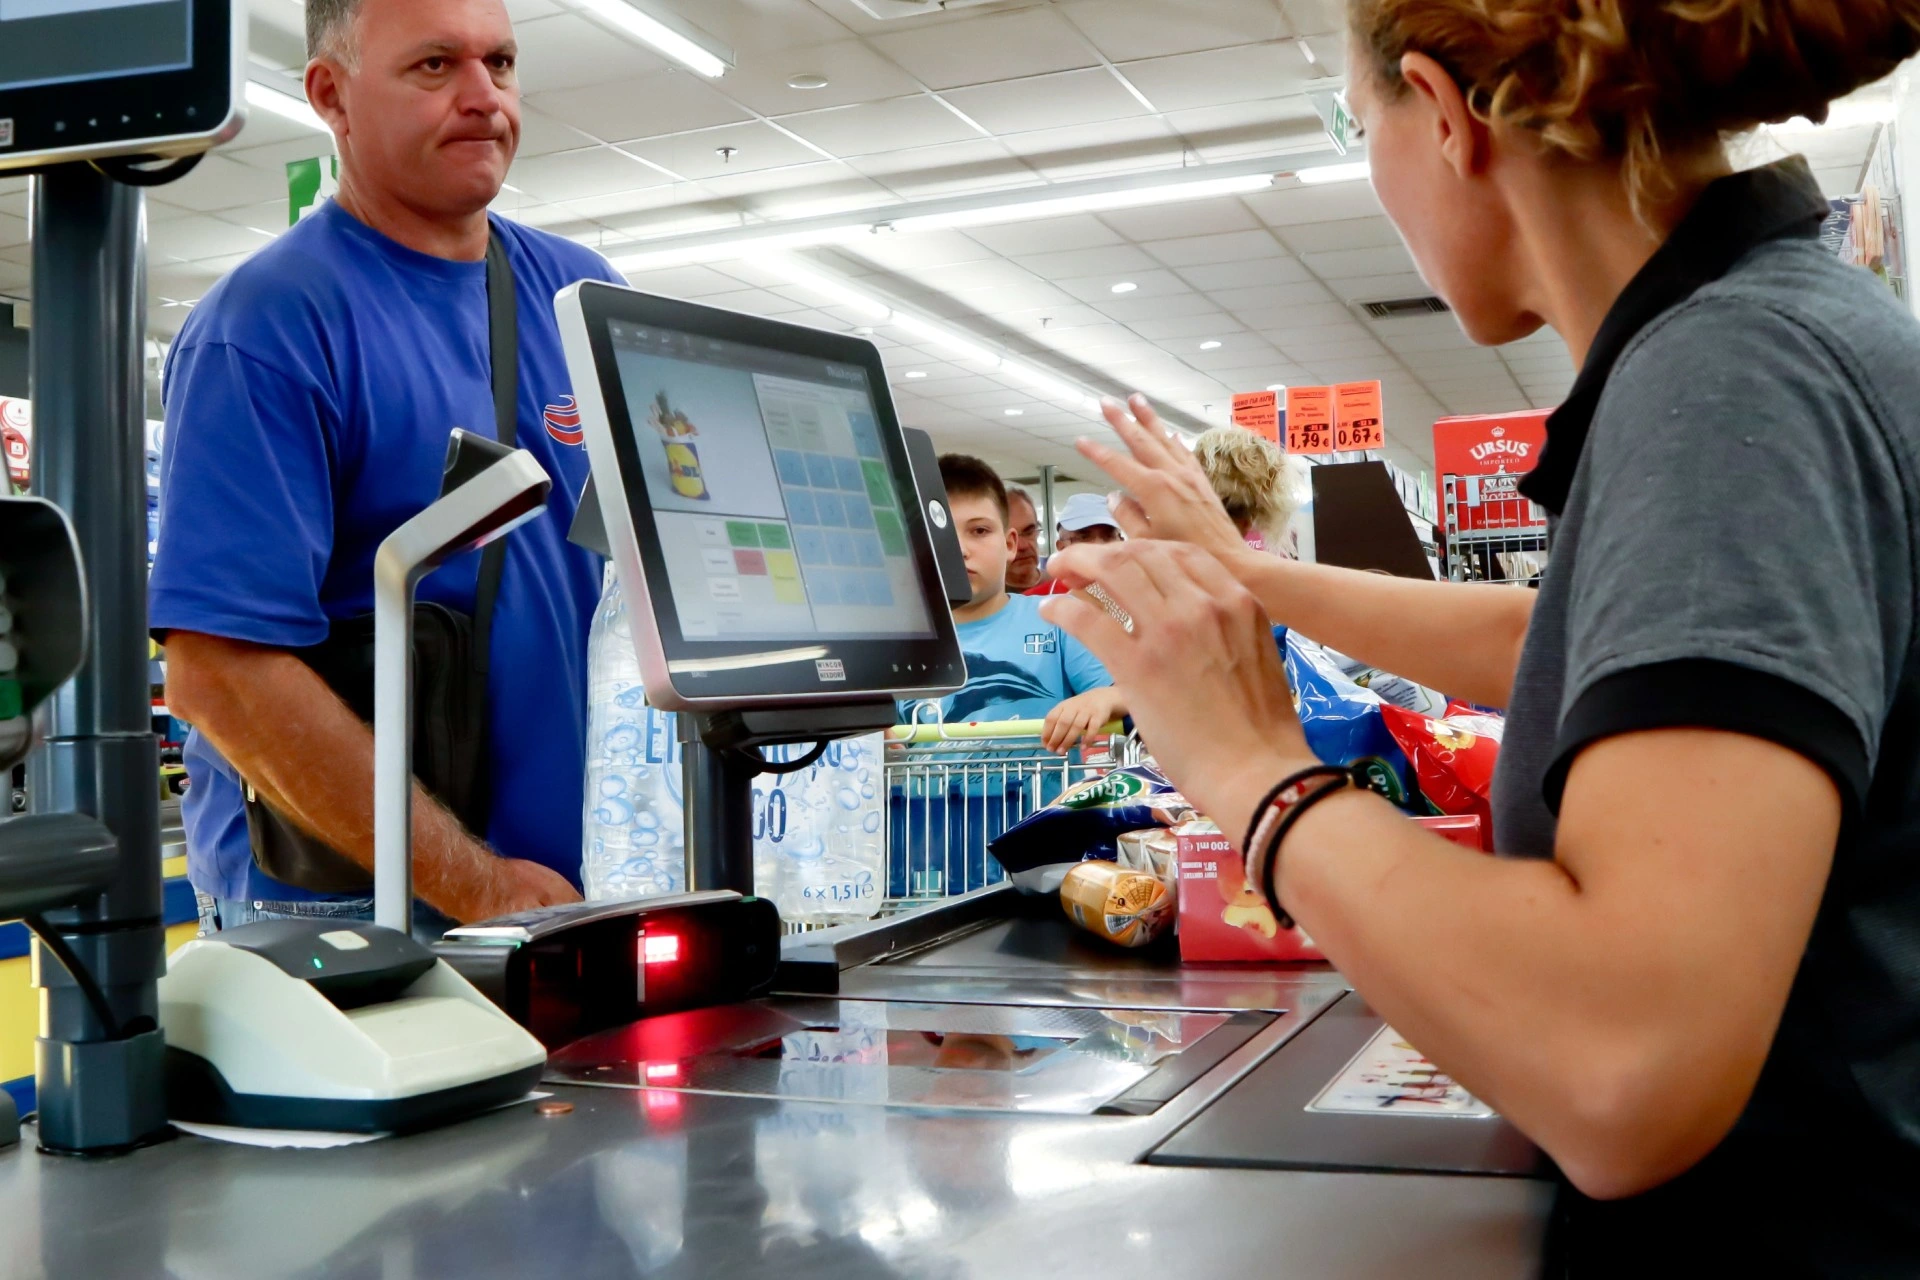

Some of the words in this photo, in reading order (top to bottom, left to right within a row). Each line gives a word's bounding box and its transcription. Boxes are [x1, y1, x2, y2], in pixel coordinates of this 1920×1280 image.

[1290, 432, 1320, 449] 1,79
[1338, 428, 1371, 446] 0,67
[1469, 440, 1530, 460] URSUS
[1480, 458, 1520, 466] IMPORTED
[817, 661, 843, 669] WINCOR
[820, 671, 845, 679] NIXDORF
[1196, 841, 1210, 852] ml
[1210, 841, 1230, 851] 200
[803, 887, 811, 898] 6
